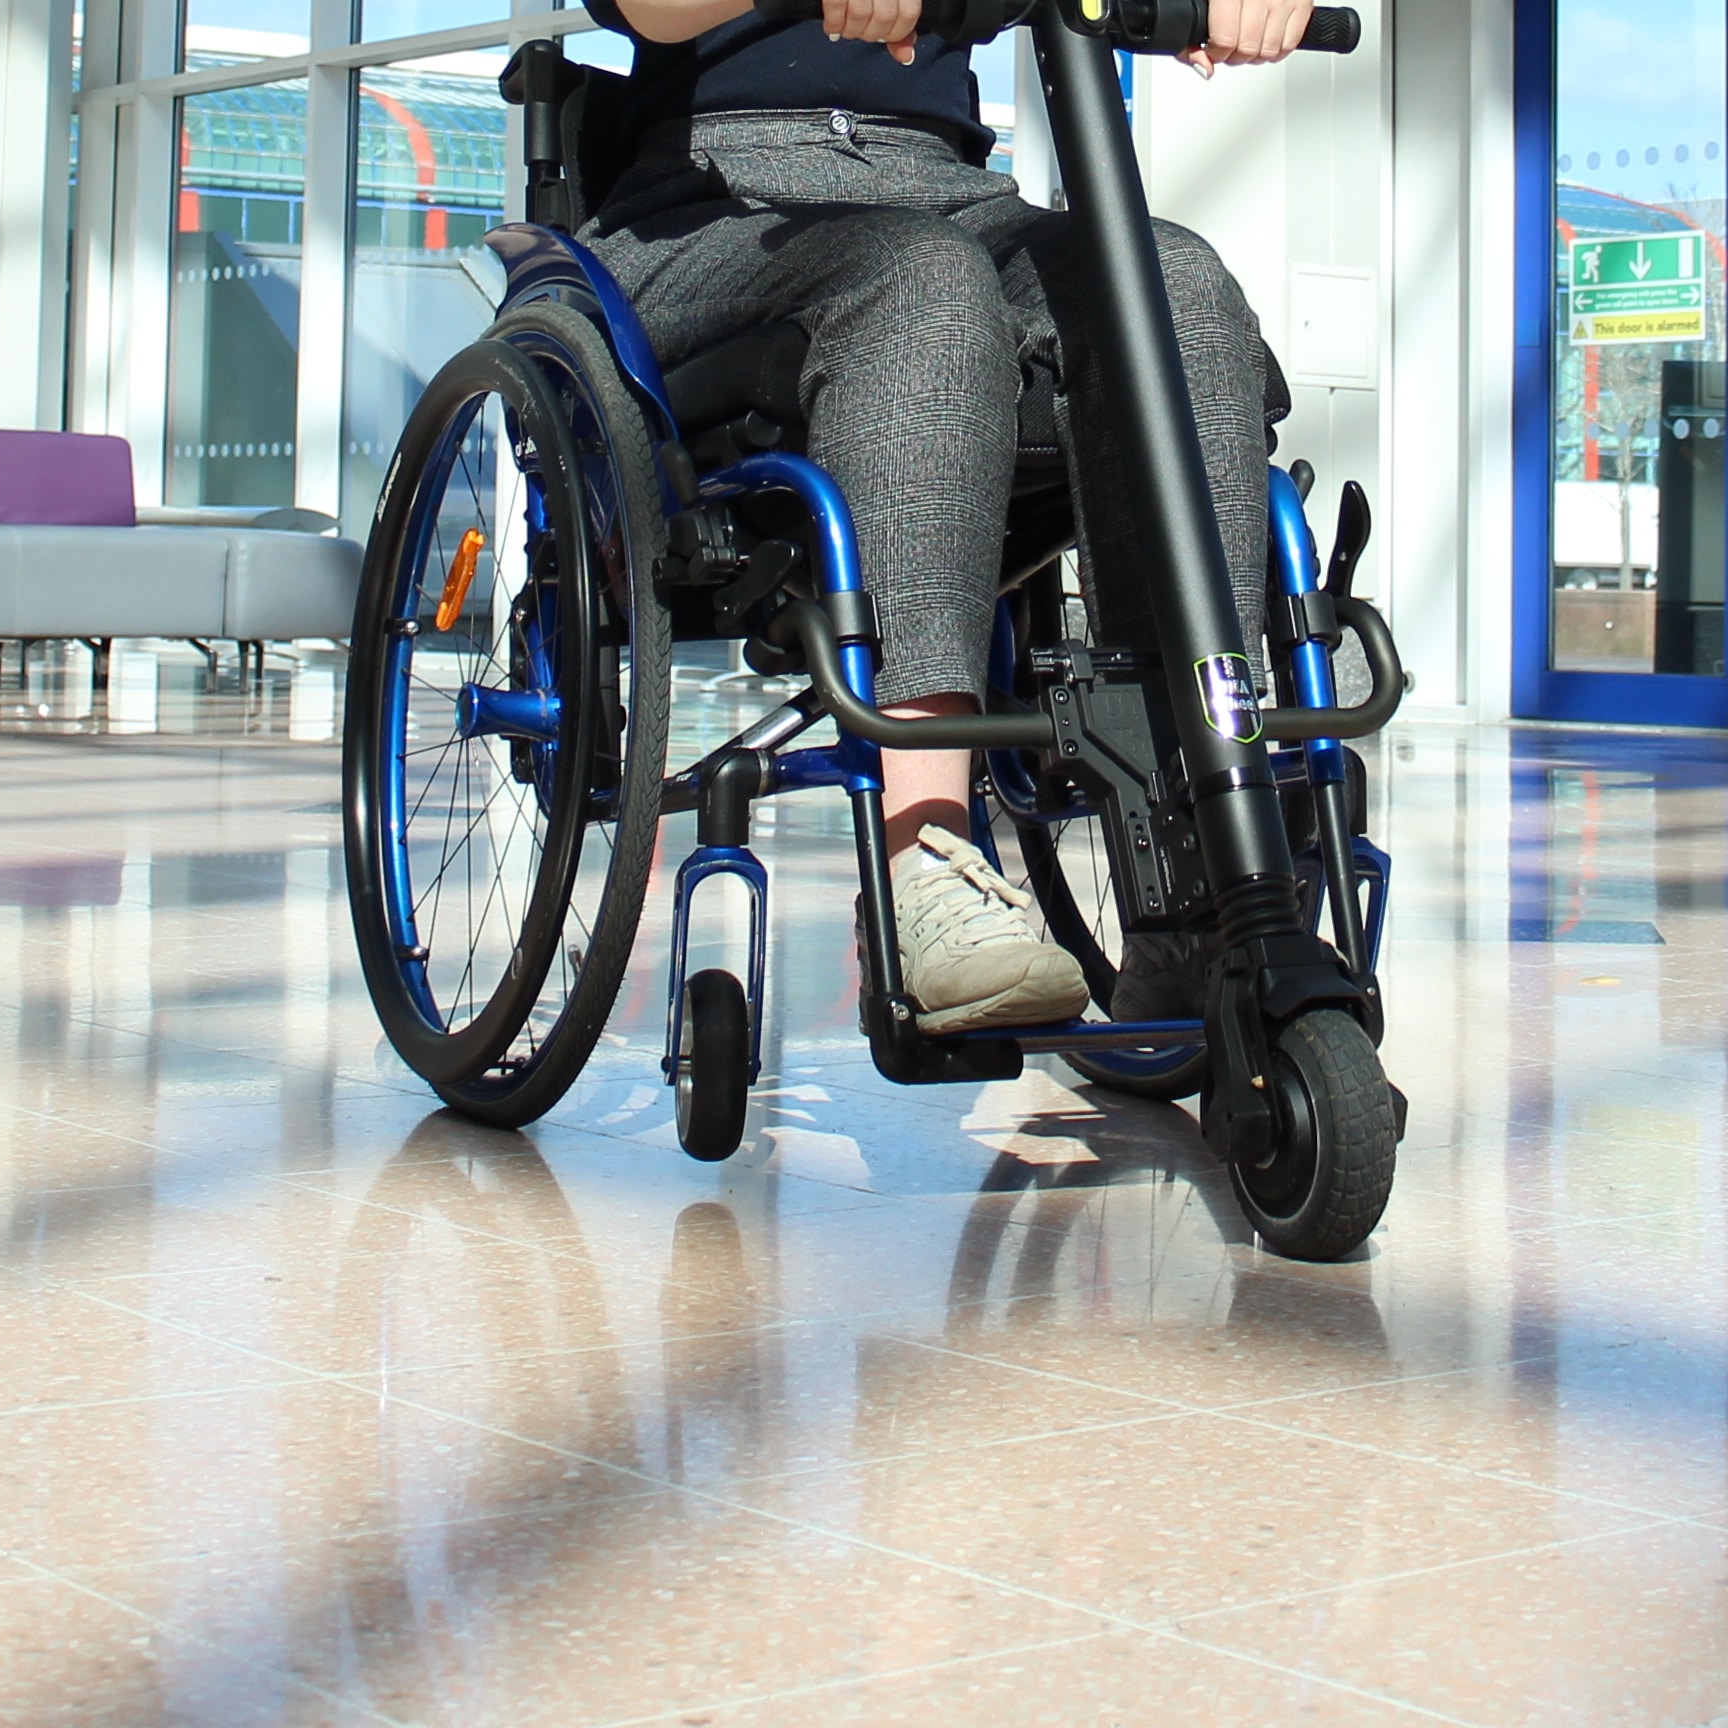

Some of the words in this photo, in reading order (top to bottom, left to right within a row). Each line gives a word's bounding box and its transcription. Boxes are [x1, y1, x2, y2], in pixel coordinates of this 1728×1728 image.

[1594, 323, 1615, 335] This
[1618, 322, 1642, 334] door
[1646, 321, 1654, 333] is
[1657, 319, 1700, 332] alarmed
